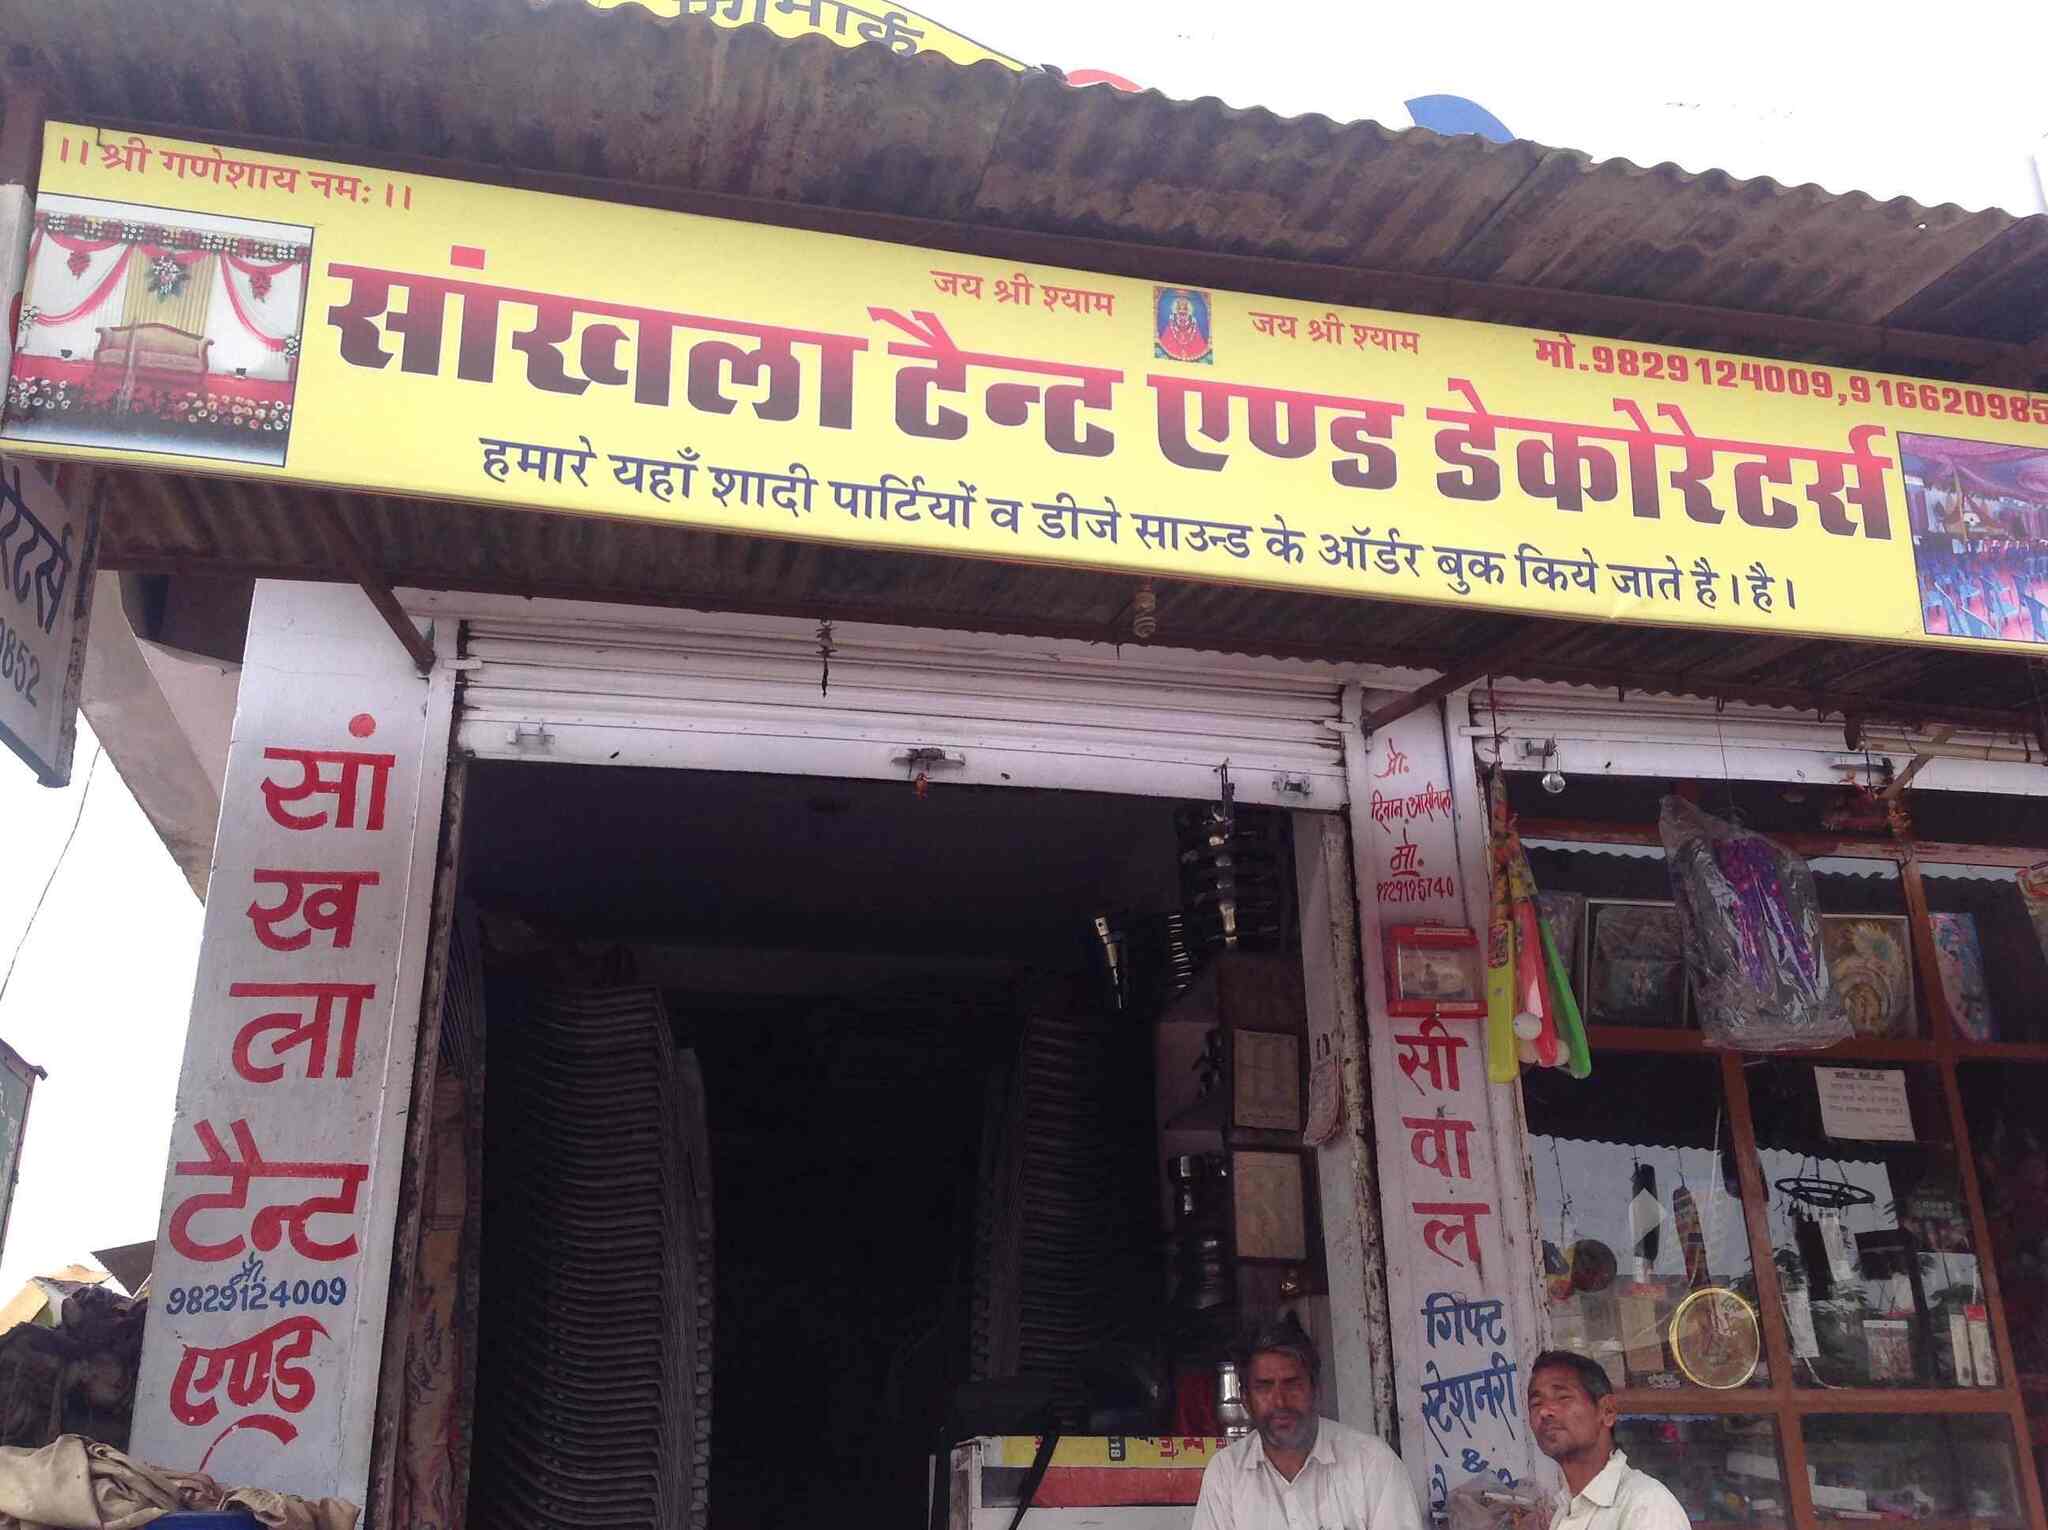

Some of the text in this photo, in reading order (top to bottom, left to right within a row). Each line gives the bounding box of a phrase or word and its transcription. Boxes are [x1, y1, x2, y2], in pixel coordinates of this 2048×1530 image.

[160, 148, 300, 194] गणेशाय
[930, 270, 1115, 317] जय श्री श्याम
[1248, 312, 1420, 355] जय श्री श्याम
[328, 245, 1893, 541] सांखला टैन्ट एण्ड डेकोरेटर्स
[479, 436, 597, 487] हमारे
[607, 447, 699, 502] यहाँ
[707, 463, 818, 518] शादी
[828, 474, 976, 529] पार्टियों
[986, 498, 1024, 534] व
[1032, 492, 1121, 544] डीजे
[1130, 513, 1253, 559] साउन्ड
[1260, 514, 1306, 564] के
[1319, 526, 1424, 578] ऑर्डर
[1433, 546, 1505, 595] बुक
[1514, 543, 1599, 594] किये
[1606, 555, 1684, 600] जाते
[0, 617, 41, 708] 852
[168, 1118, 368, 1262] टैन्ट
[166, 1277, 347, 1315] 9829124009
[1421, 1292, 1506, 1348] गिफ्ट
[169, 1315, 330, 1427] एण्ड
